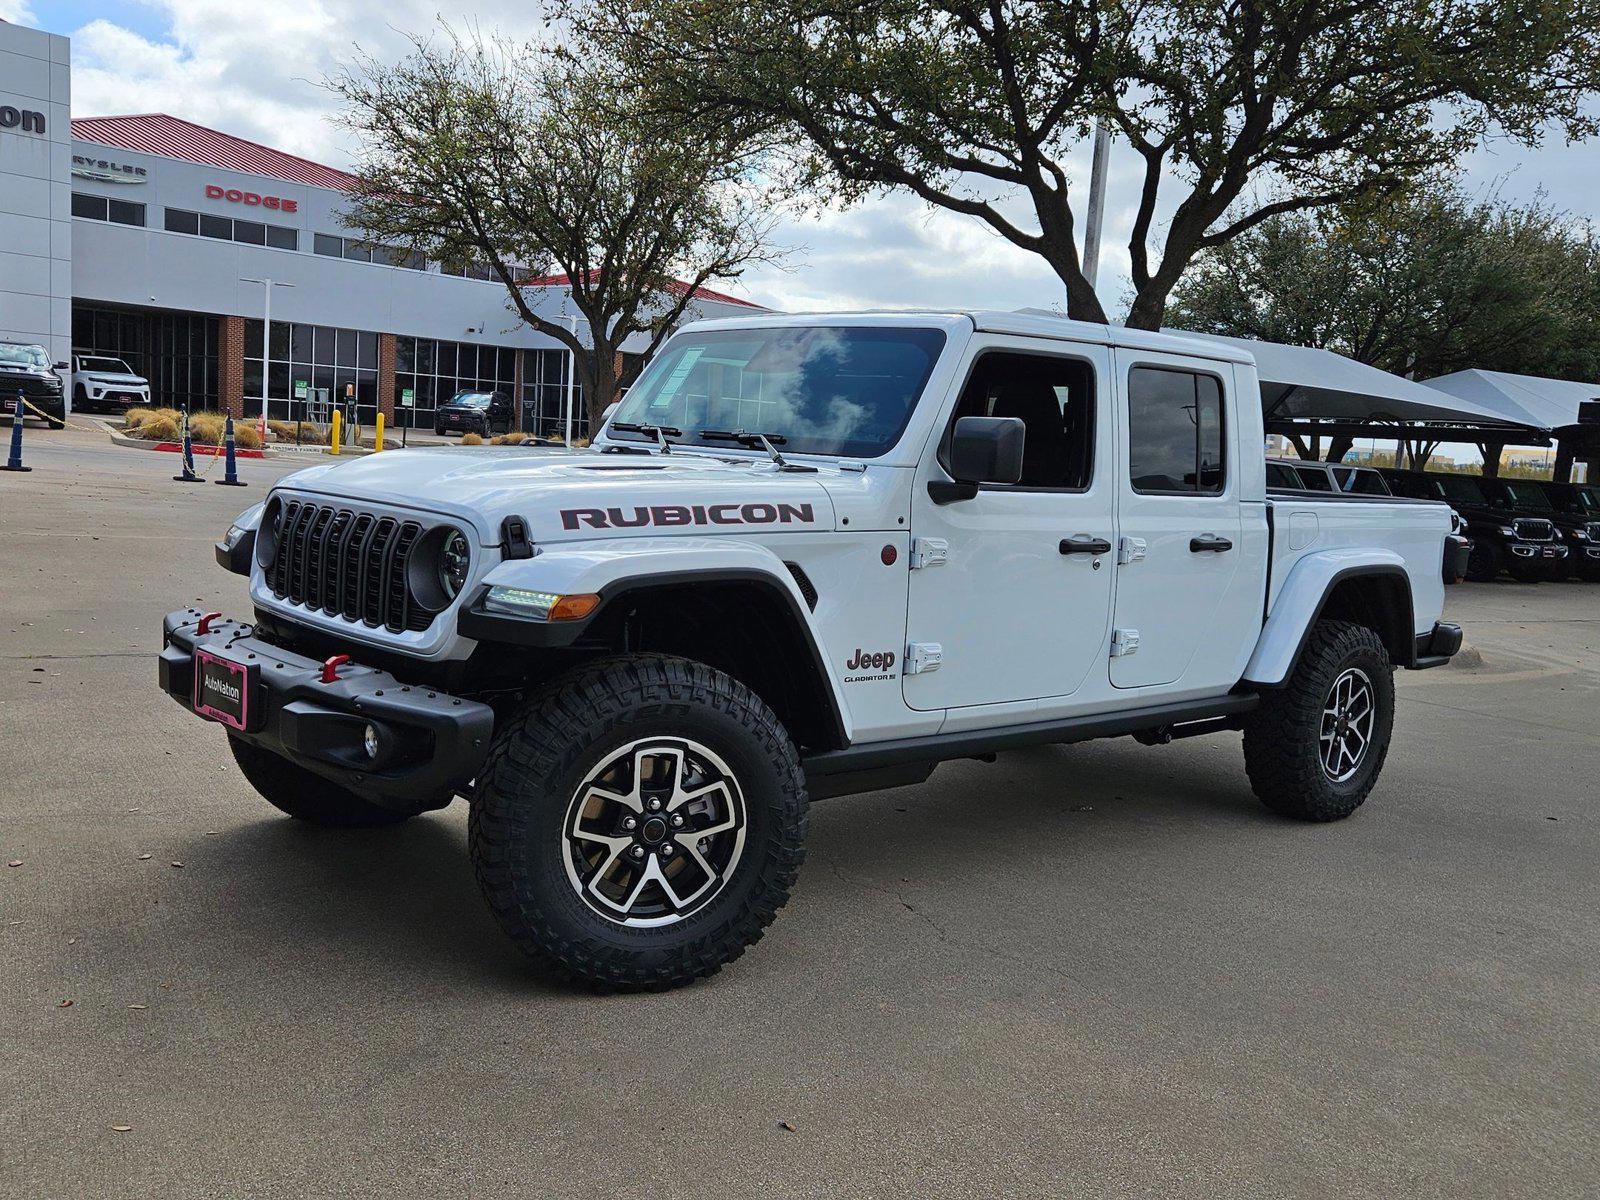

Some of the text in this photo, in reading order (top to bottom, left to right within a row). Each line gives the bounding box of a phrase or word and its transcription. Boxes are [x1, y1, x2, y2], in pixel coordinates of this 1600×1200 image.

[205, 184, 298, 213] DODGE
[559, 503, 815, 530] RUBICON
[846, 648, 896, 672] Jeep
[204, 674, 240, 700] AutoNation
[844, 674, 888, 683] GLADIATOR
